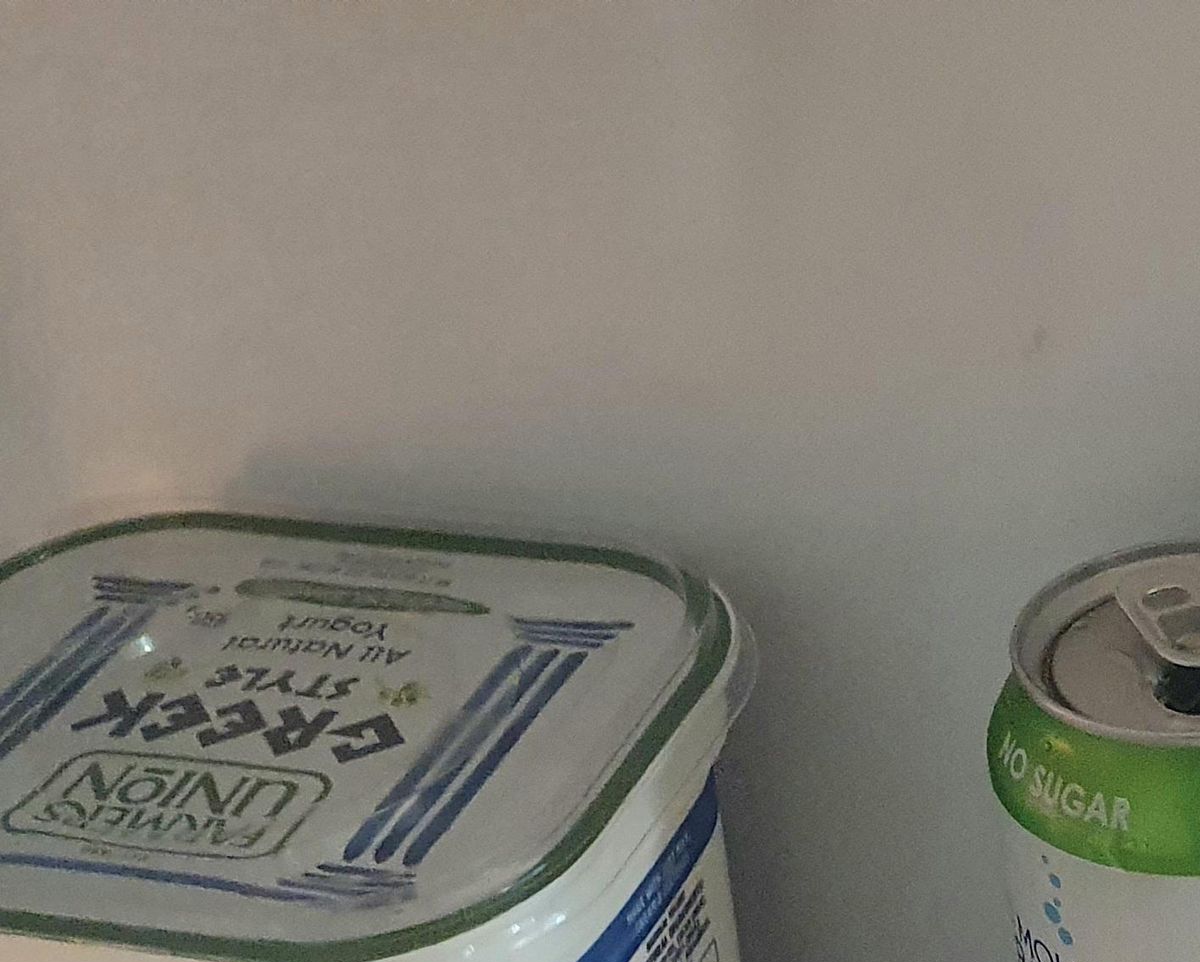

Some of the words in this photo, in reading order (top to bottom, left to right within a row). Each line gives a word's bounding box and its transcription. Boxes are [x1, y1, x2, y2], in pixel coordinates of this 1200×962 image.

[221, 634, 354, 662] Natural
[277, 613, 389, 642] Yogurt
[357, 645, 414, 668] All
[204, 663, 361, 700] STYLE
[70, 687, 408, 764] GREEK
[61, 761, 300, 818] UNION
[998, 730, 1028, 781] NO
[1026, 763, 1133, 832] SUGAR
[33, 800, 267, 849] FARMERS
